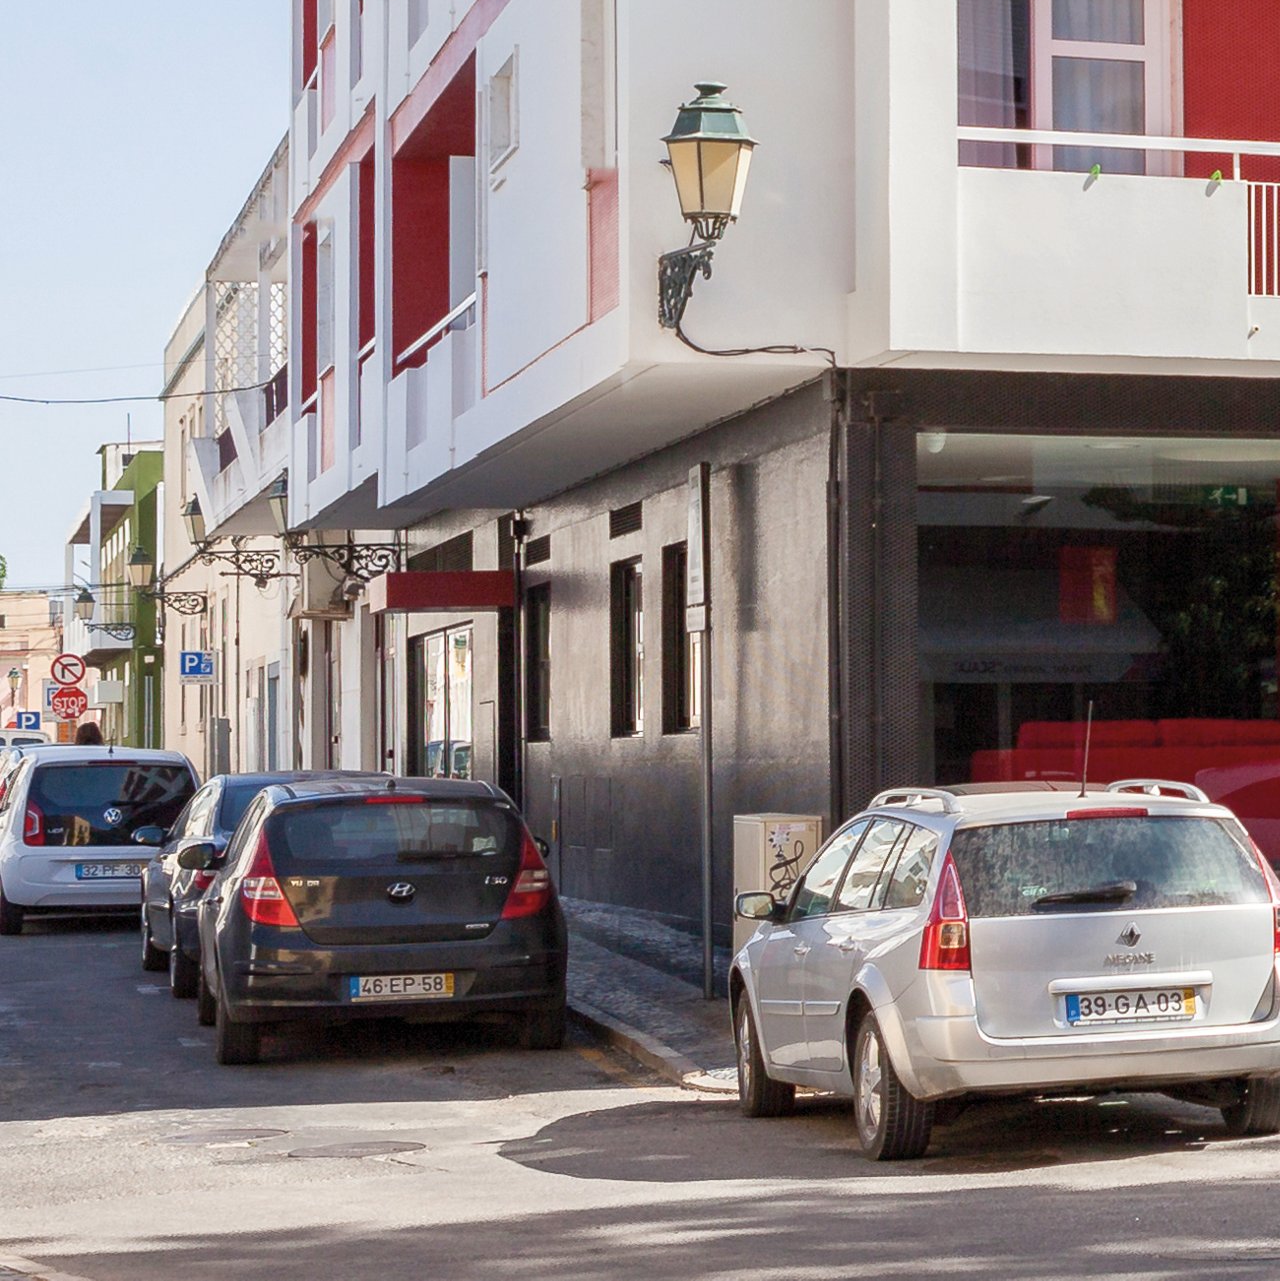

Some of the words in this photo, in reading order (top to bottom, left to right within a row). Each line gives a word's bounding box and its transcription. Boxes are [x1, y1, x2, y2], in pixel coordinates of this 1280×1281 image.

[185, 655, 198, 673] P
[53, 697, 87, 710] STOP
[21, 714, 35, 729] P
